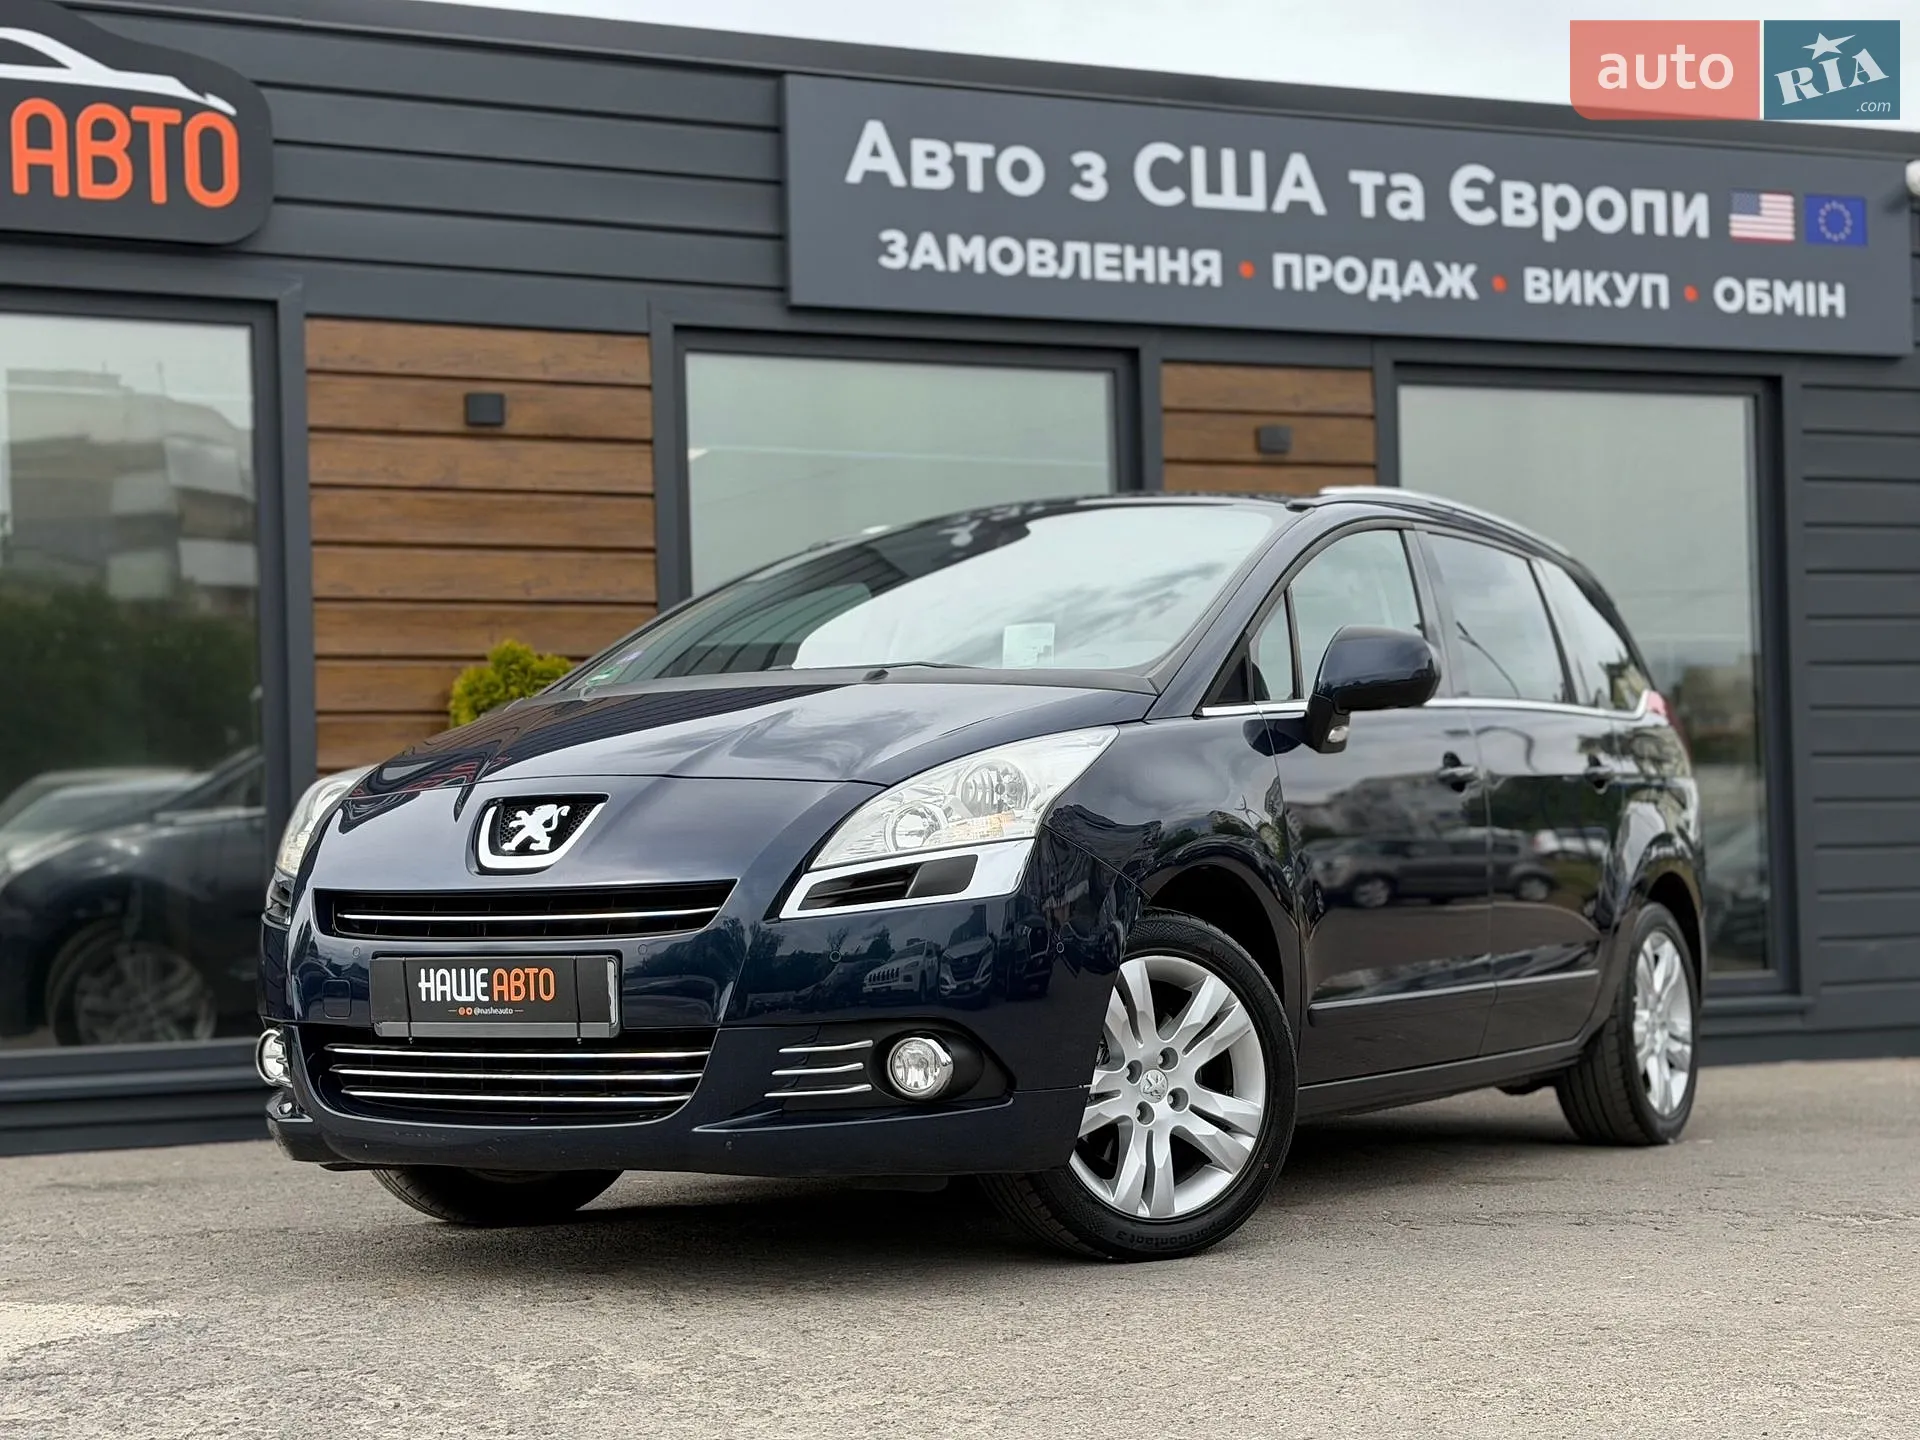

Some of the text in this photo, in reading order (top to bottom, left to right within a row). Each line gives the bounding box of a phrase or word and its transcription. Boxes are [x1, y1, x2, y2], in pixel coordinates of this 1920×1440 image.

[10, 97, 239, 208] АВТО
[845, 119, 1710, 242] Авто з США та Європи
[878, 229, 1846, 318] ЗАМОВЛЕННЯ ПРОДАЖ ВИКУП ОБМІН
[418, 968, 556, 1002] НАШЕ АВТО
